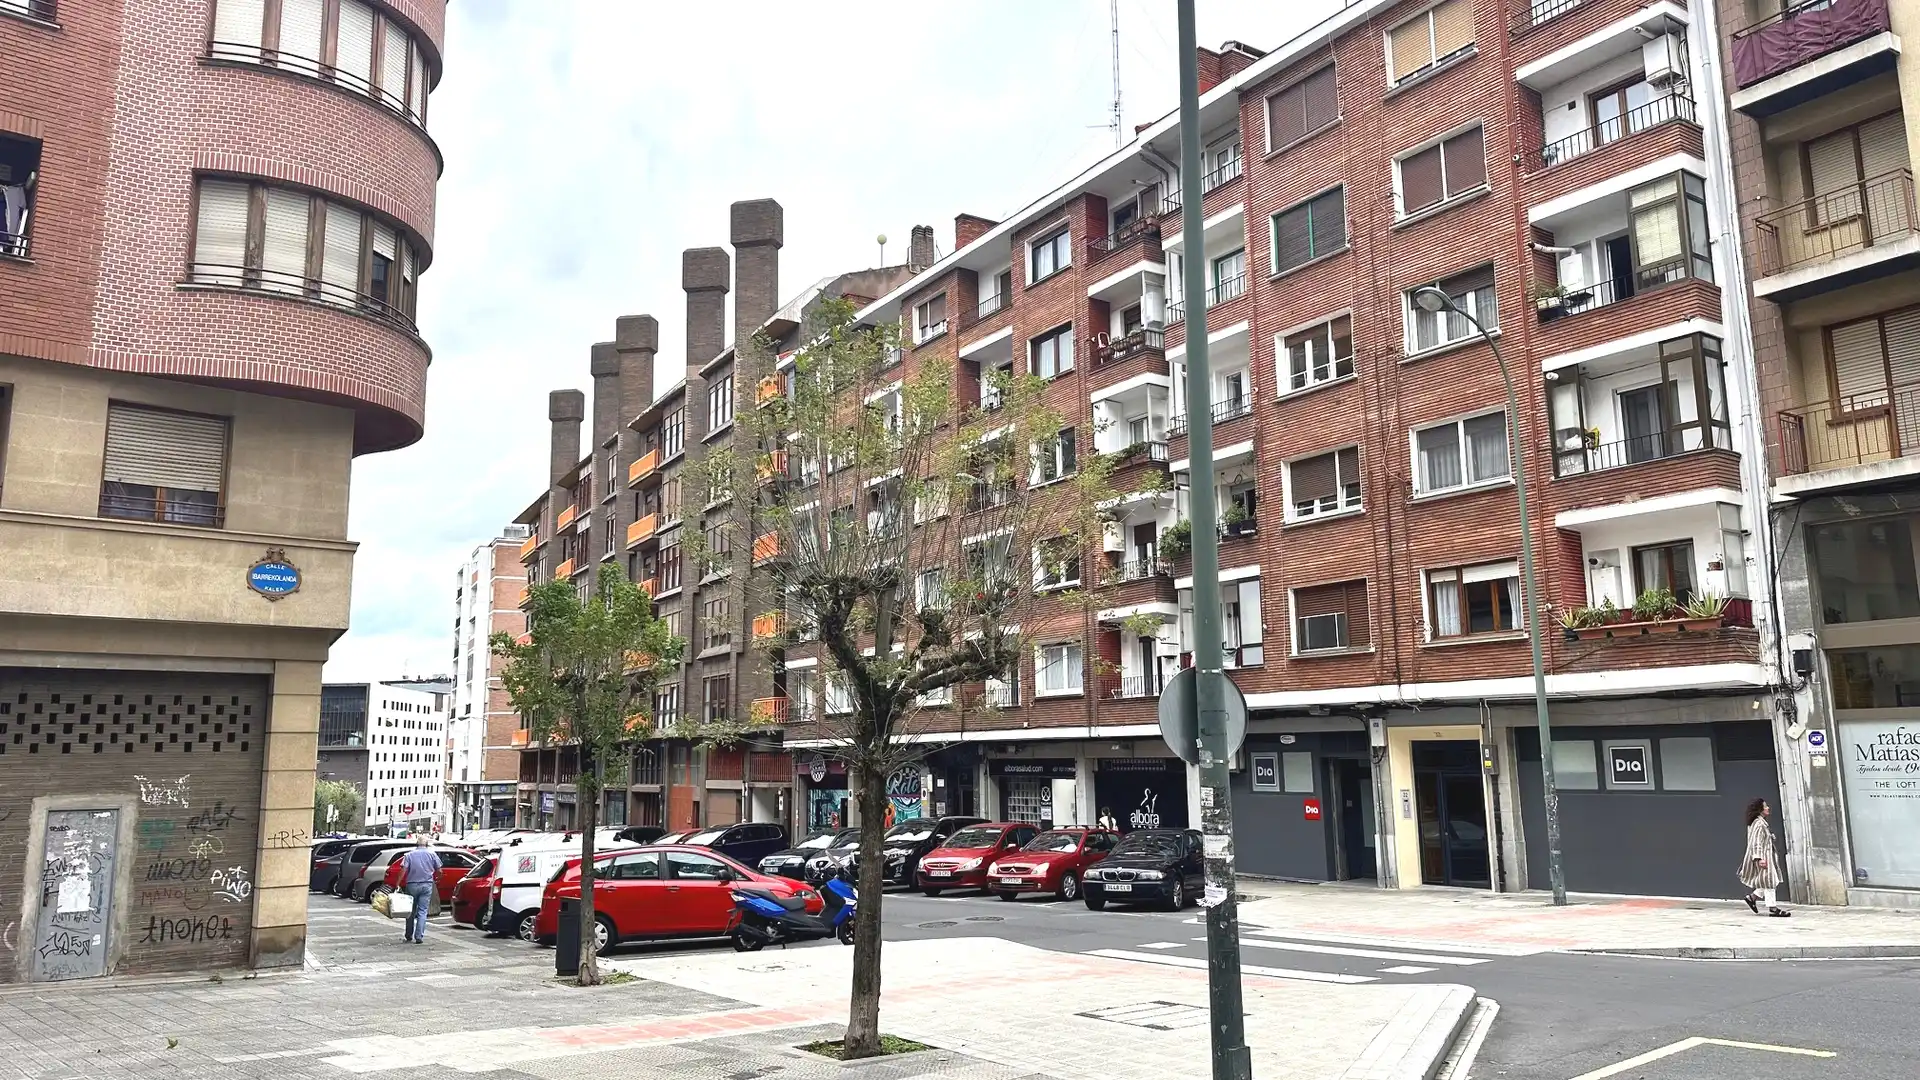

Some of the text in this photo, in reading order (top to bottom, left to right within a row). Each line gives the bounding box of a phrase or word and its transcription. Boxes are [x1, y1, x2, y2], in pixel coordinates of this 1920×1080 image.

[252, 572, 297, 583] IBARREKOLANDA
[1854, 743, 1920, 762] Matías
[1004, 764, 1044, 773] alborasalud.com
[1882, 764, 1902, 772] desde
[1875, 781, 1917, 789] THE LOFT
[1130, 809, 1160, 824] albora
